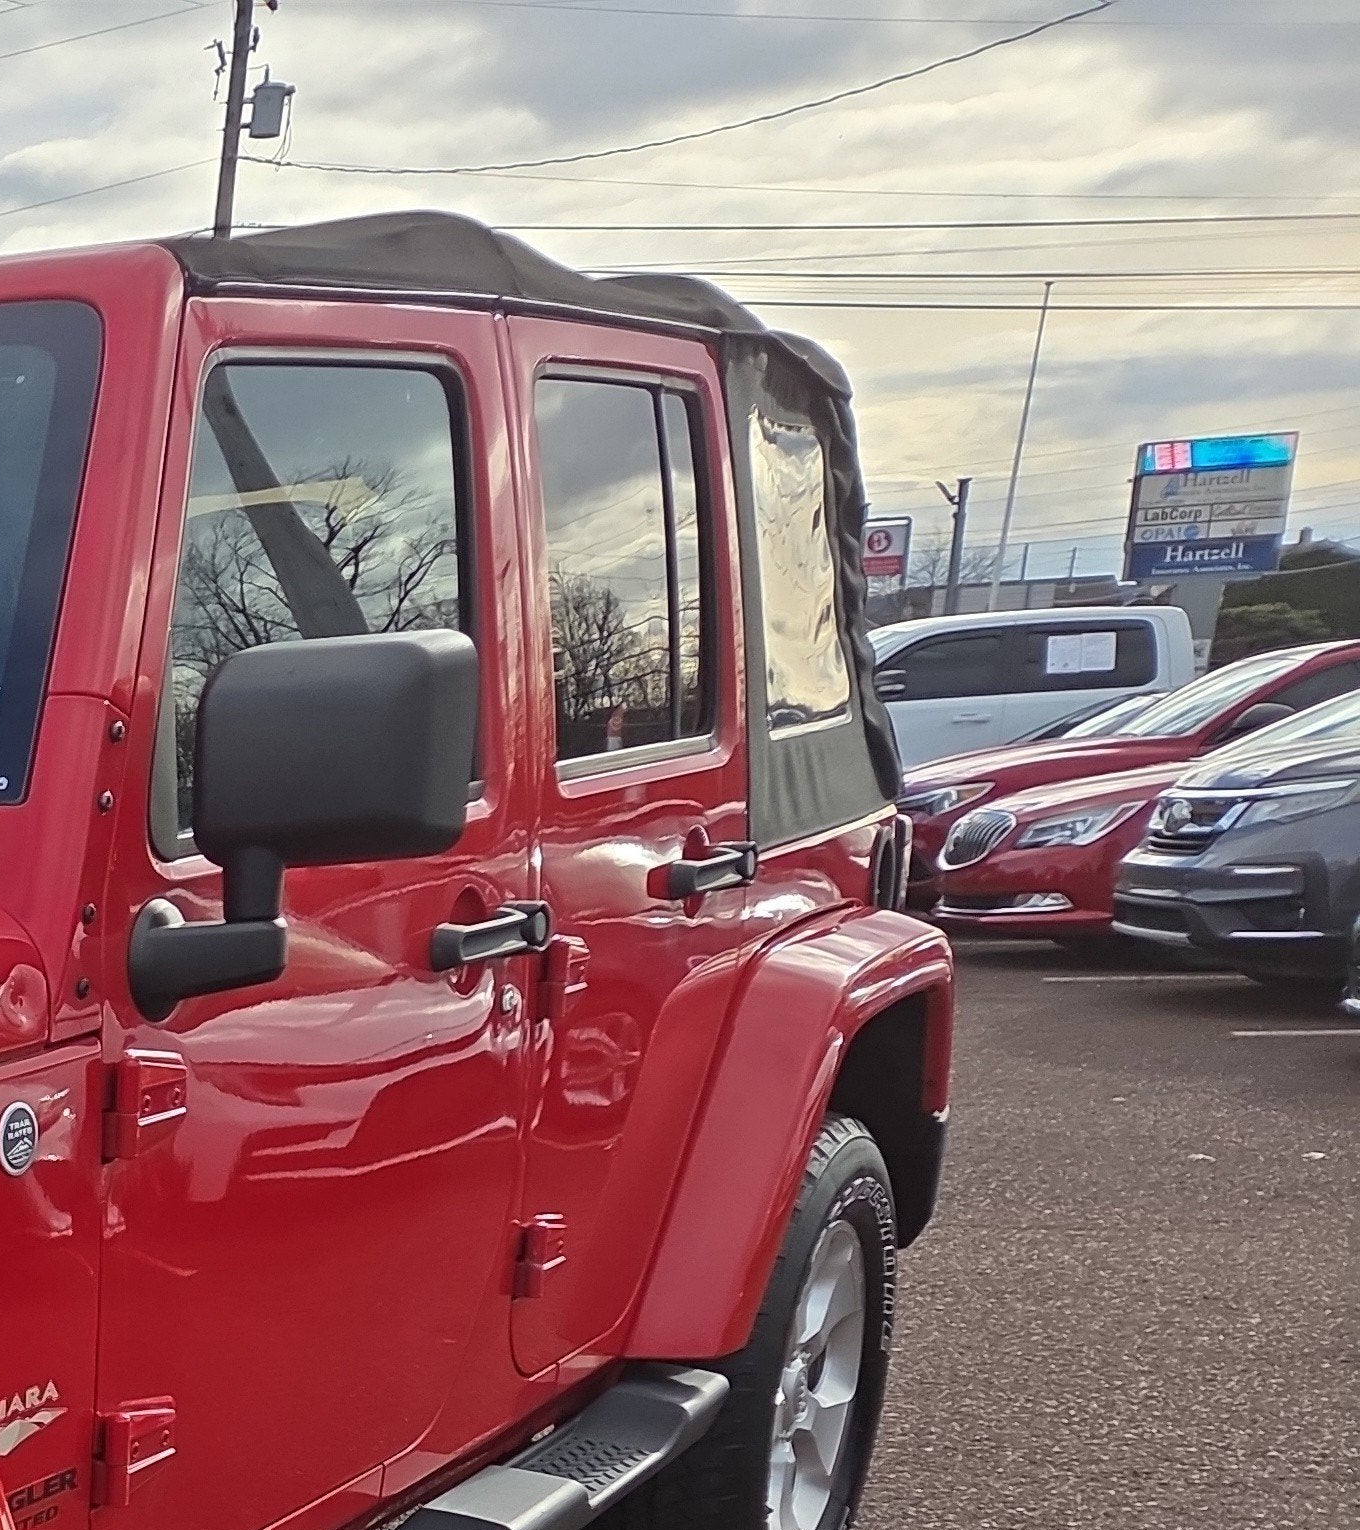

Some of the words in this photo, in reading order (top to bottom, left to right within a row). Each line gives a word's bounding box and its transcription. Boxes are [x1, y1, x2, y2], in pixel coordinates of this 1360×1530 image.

[1143, 507, 1203, 523] LabCorp
[1164, 542, 1244, 562] Hartzell
[8, 1469, 78, 1511] GLER
